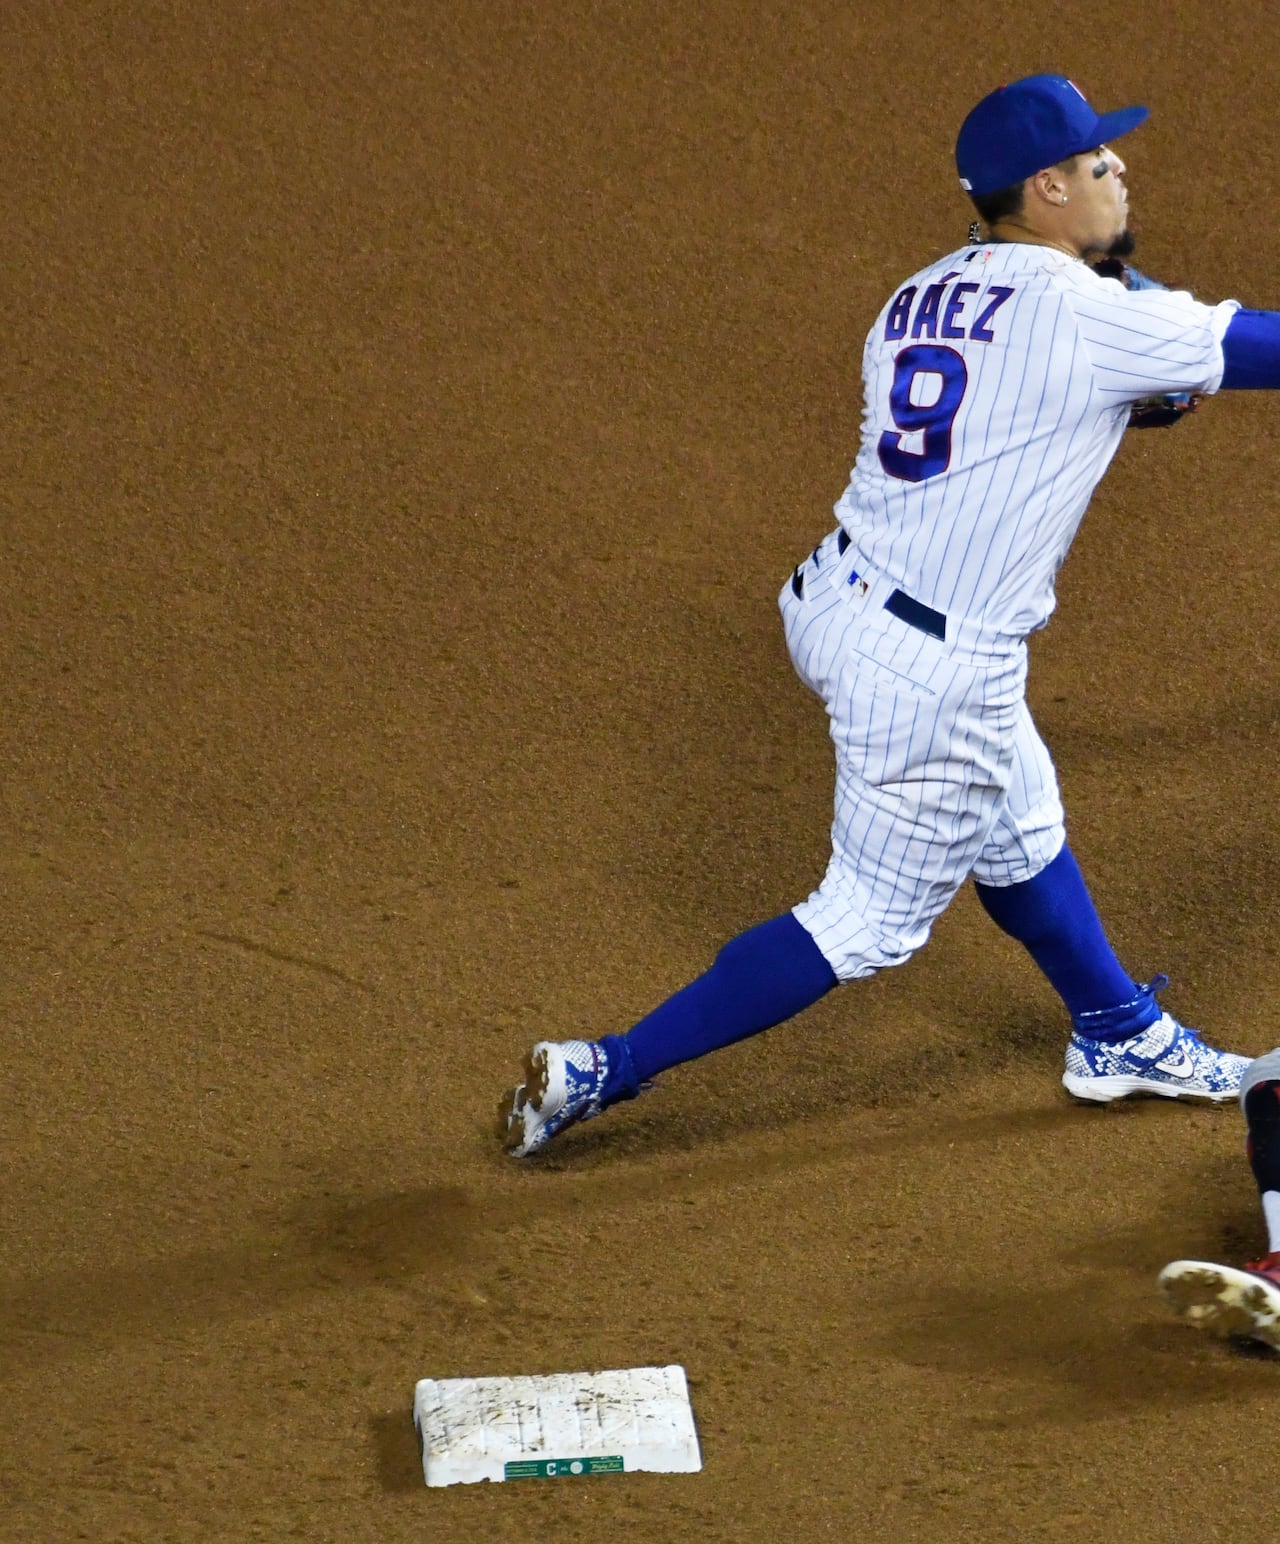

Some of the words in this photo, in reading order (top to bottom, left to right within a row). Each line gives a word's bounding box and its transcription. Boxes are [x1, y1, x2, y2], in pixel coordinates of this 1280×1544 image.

[884, 272, 1015, 342] BÁEZ
[878, 344, 968, 482] 9
[546, 1463, 557, 1476] C
